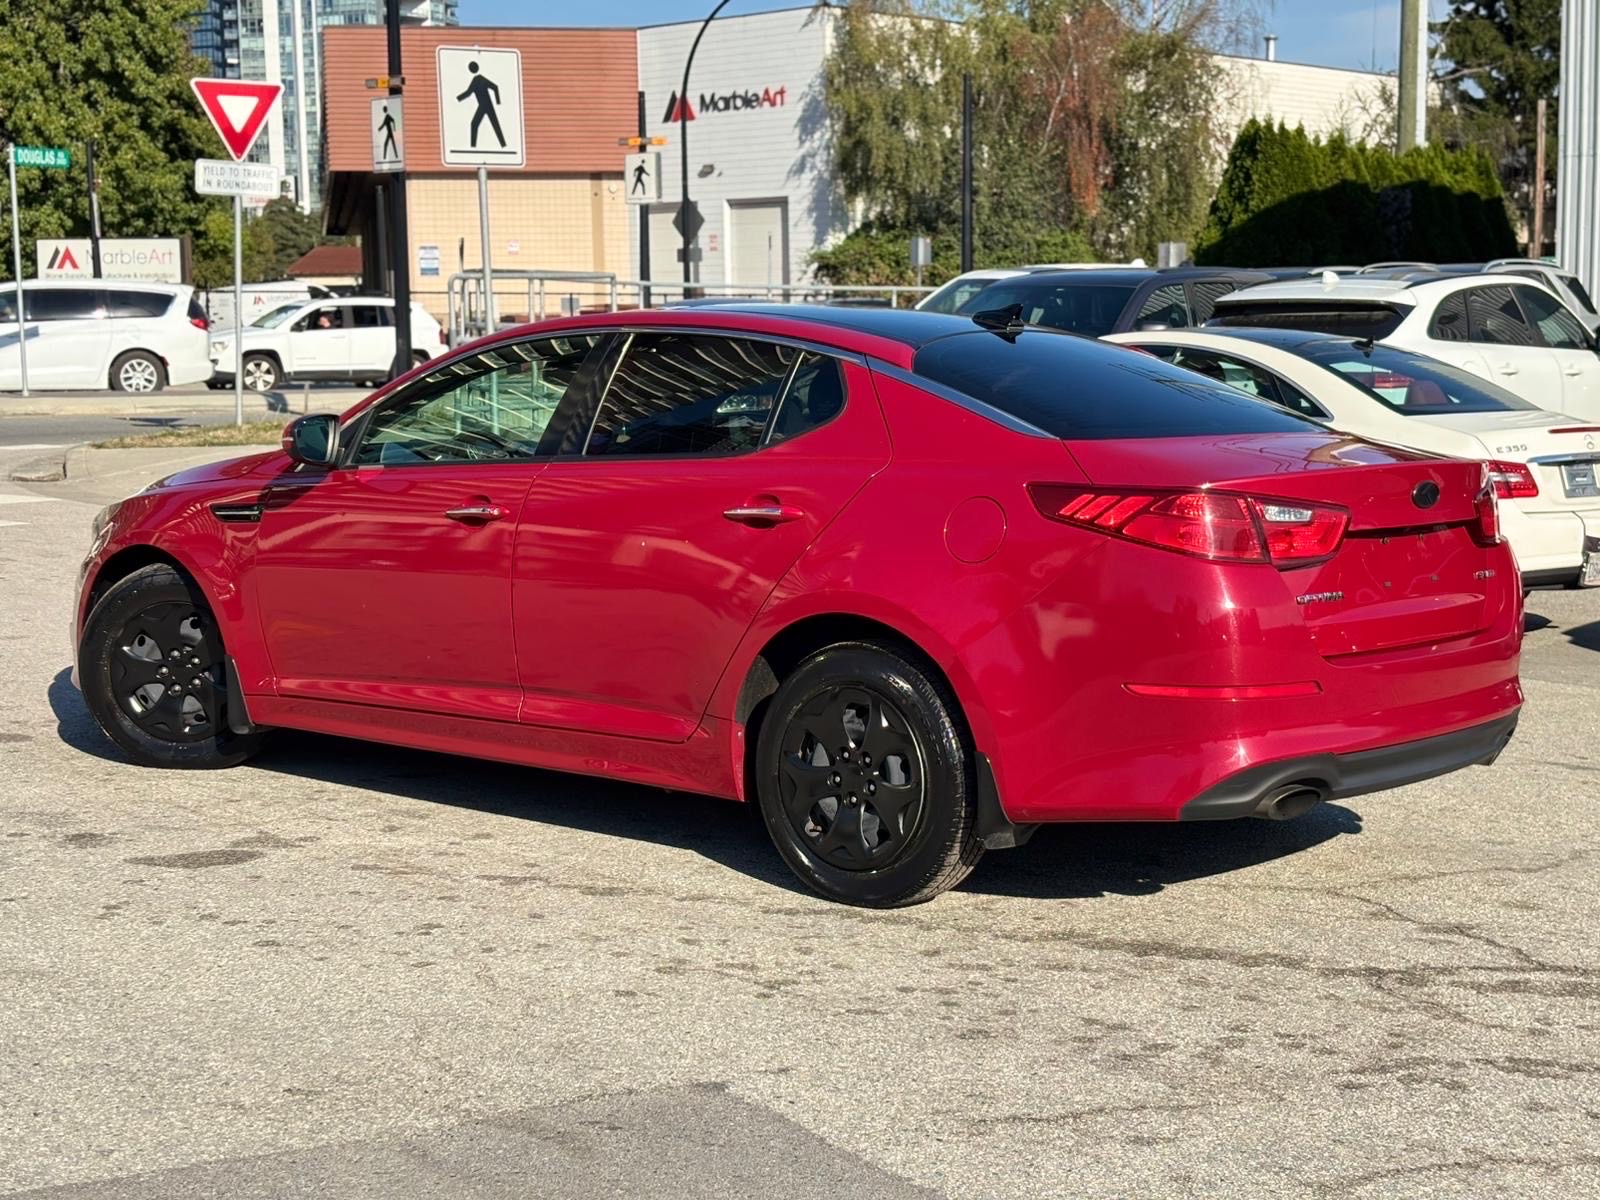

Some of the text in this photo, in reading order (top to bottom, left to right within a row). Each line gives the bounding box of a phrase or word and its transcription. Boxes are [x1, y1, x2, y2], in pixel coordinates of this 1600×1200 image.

[700, 86, 787, 113] MarbleArt
[17, 148, 55, 165] DOUGLAS
[203, 166, 275, 179] YIELD TO TRAFFIC
[203, 179, 273, 192] IN ROUNDABOUT
[1505, 444, 1528, 453] 350
